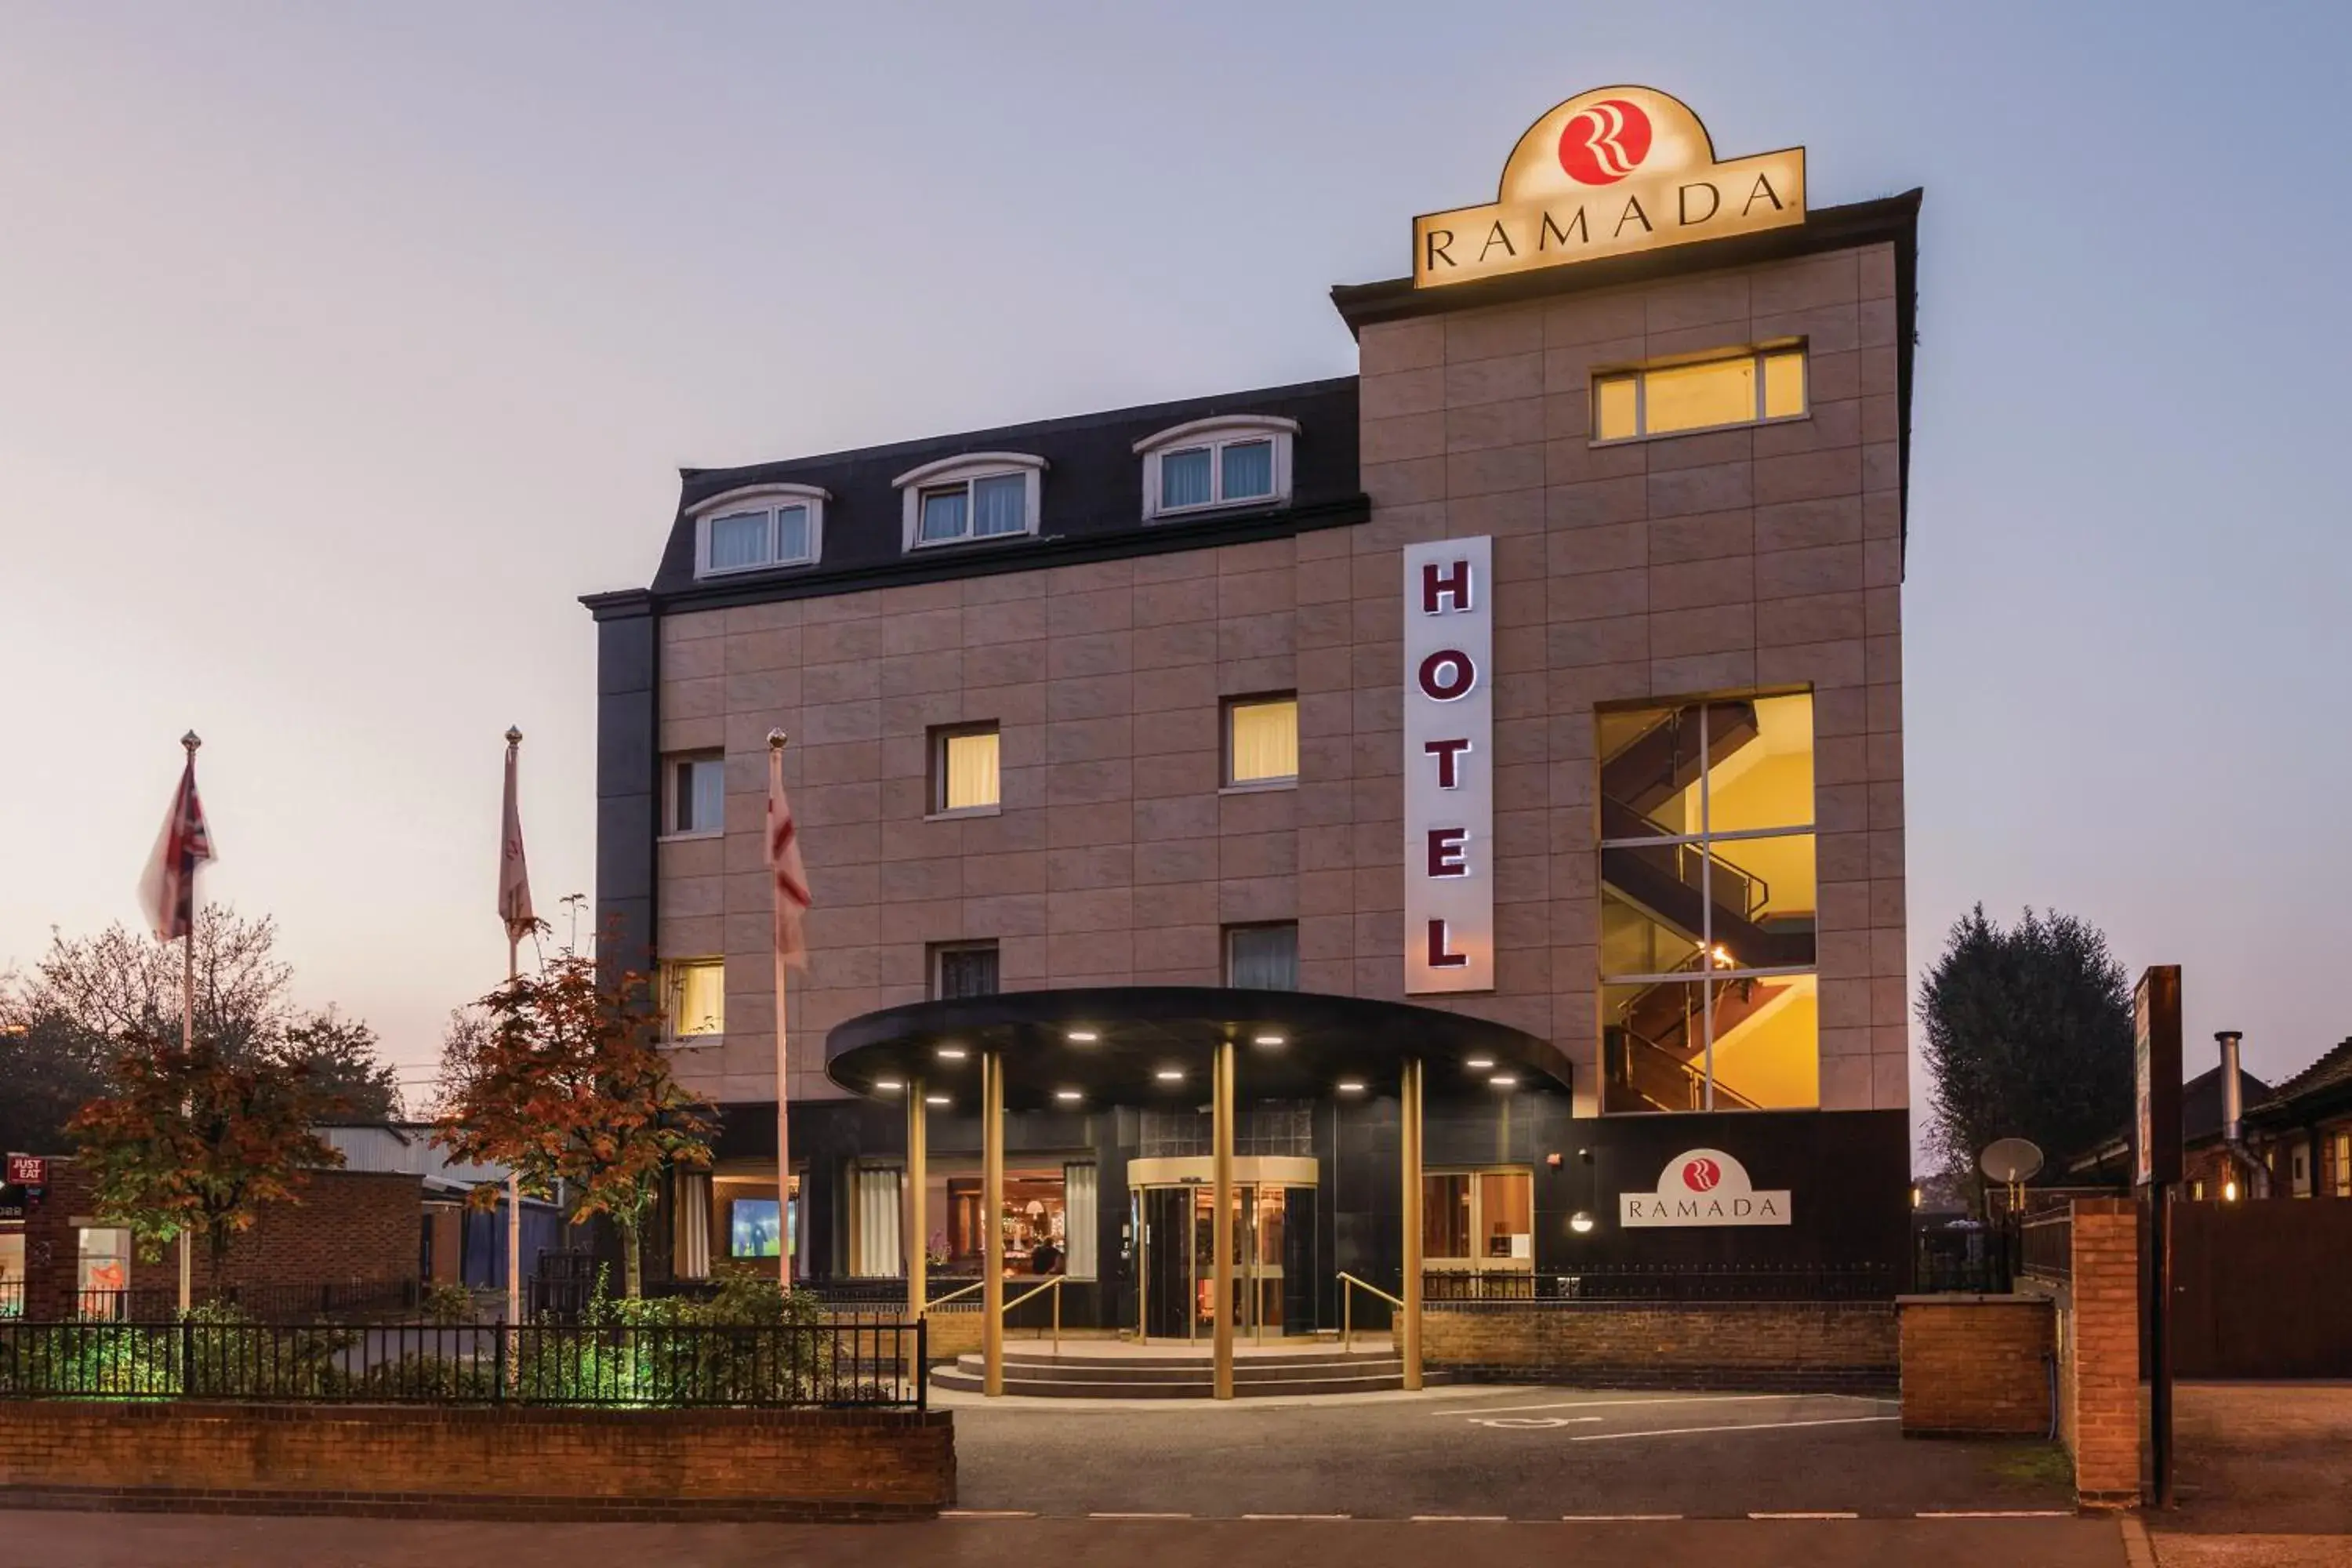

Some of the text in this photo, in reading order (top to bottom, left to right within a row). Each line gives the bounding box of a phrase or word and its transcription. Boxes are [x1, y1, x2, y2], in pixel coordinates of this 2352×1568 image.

[1426, 172, 1785, 271] RAMADA
[1418, 561, 1476, 968] HOTEL
[13, 1160, 42, 1169] JUST
[20, 1169, 42, 1178] EAT
[1629, 1198, 1777, 1218] RAMADA
